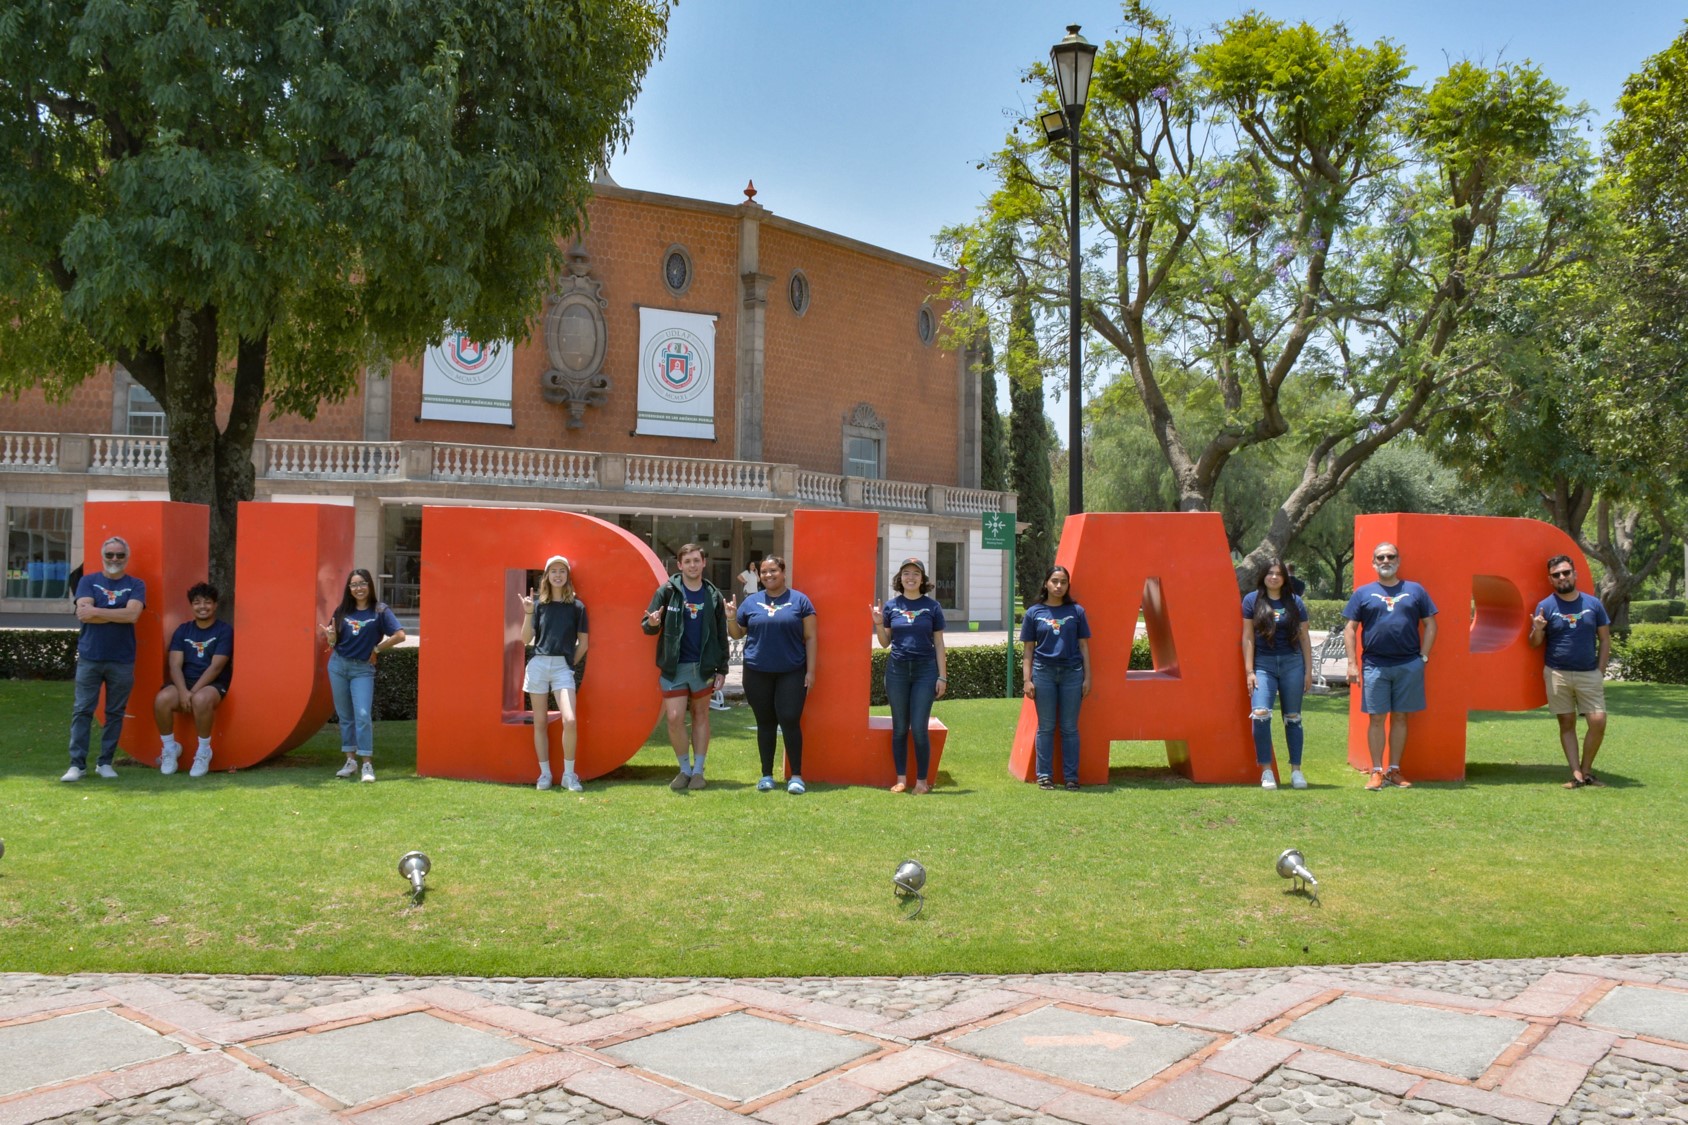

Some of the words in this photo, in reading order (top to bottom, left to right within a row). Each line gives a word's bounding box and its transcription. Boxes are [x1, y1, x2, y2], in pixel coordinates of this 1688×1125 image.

[665, 330, 692, 339] UDLAP
[455, 374, 482, 382] MCMXL
[85, 501, 1590, 785] UDLAP
